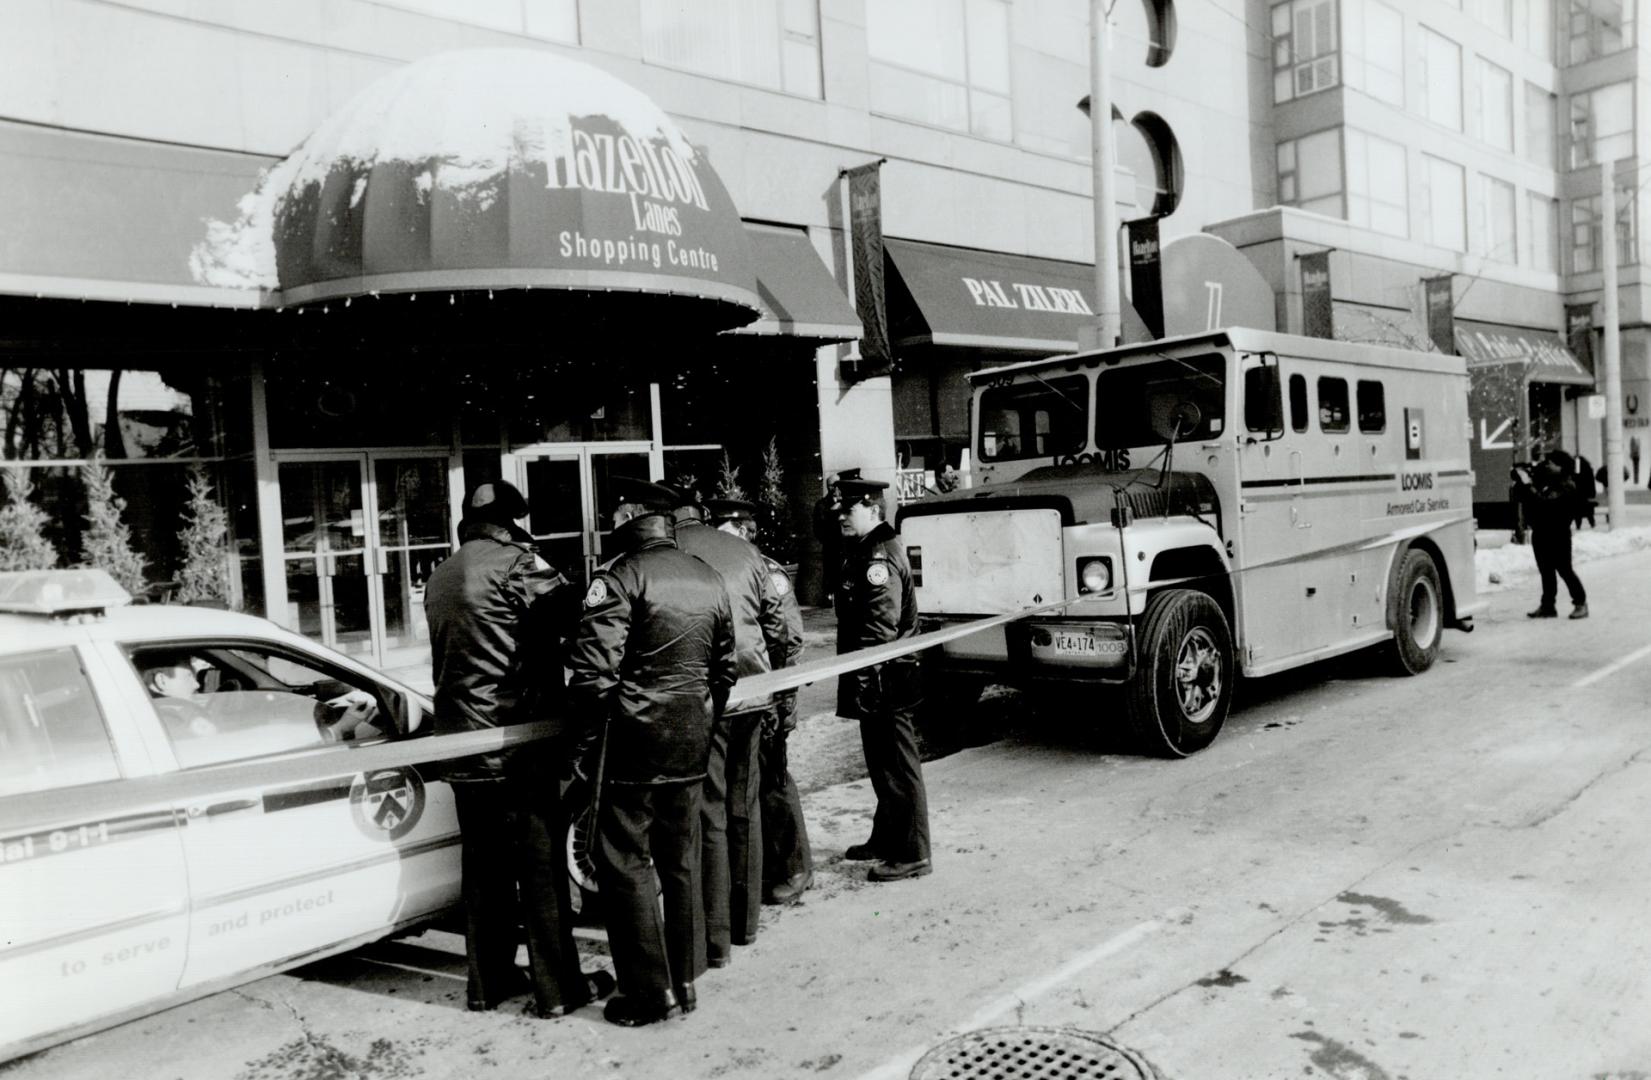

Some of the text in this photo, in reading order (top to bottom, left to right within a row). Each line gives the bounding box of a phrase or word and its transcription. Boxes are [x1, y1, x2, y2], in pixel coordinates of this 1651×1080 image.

[629, 191, 682, 236] Lanes
[559, 231, 719, 272] Shopping Centre
[961, 277, 1094, 315] PAL ZILERI
[1401, 472, 1433, 491] LOOMIS
[1386, 498, 1449, 517] Armored Car Service
[60, 890, 335, 978] to serve and protect
